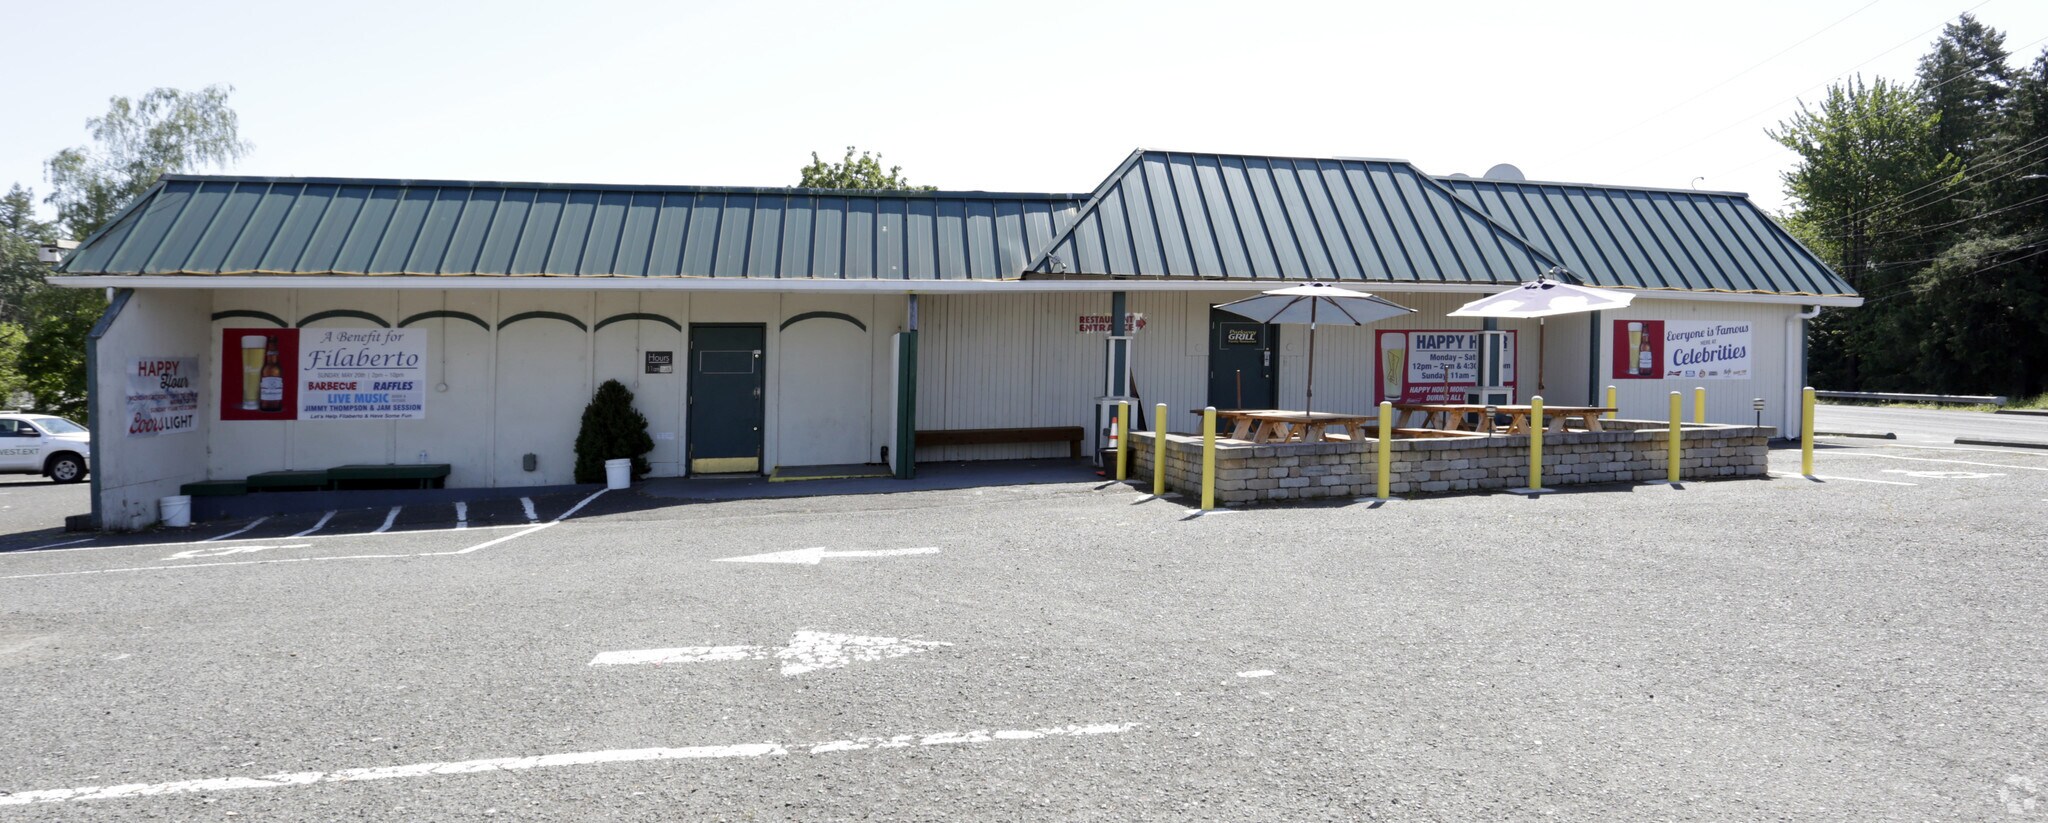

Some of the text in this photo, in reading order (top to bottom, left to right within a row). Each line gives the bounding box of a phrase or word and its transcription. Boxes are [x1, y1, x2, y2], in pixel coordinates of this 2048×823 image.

[1079, 315, 1134, 324] RESTAUNT
[1079, 323, 1134, 331] ENTRACE
[1667, 325, 1749, 342] Everyone is Famous
[320, 330, 404, 345] A Benefit for
[1416, 335, 1464, 349] HAPPY
[304, 348, 418, 370] Filaberto
[648, 353, 670, 361] Hours
[1430, 354, 1457, 362] Monday
[1673, 344, 1746, 366] Celebrities
[138, 361, 180, 376] HAPPY
[1412, 363, 1432, 371] 12pm
[160, 373, 189, 389] Hour
[308, 382, 413, 391] BARBECUE RAFFLES
[328, 393, 389, 404] LIVE MUSIC
[129, 412, 193, 434] Coors LIGHT
